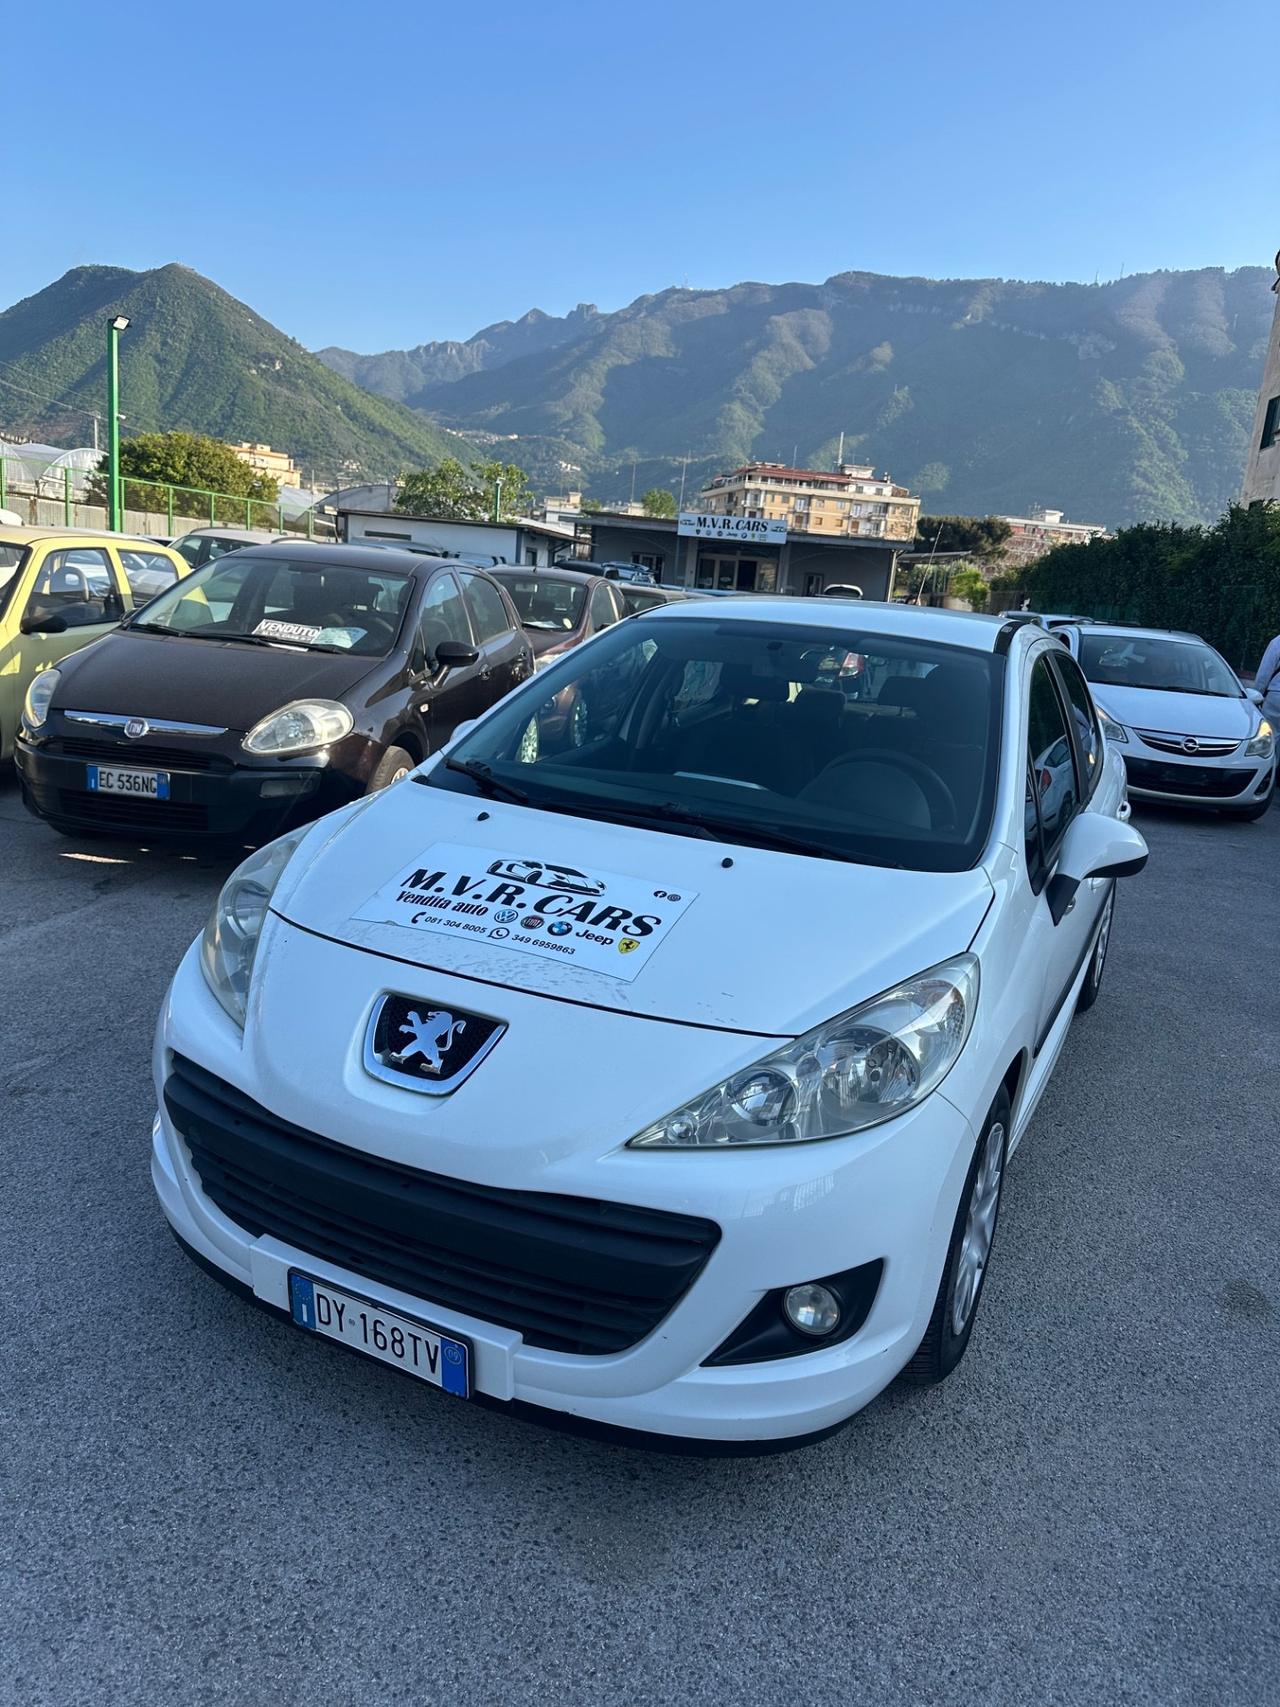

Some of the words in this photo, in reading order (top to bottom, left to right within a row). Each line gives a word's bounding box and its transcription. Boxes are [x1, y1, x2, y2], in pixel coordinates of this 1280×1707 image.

[260, 621, 319, 637] VENDUTO
[98, 771, 114, 789] EC
[396, 890, 452, 910] Vendita
[451, 900, 489, 917] auto
[424, 916, 442, 924] 081
[443, 919, 462, 929] 304
[462, 923, 488, 934] 8005
[511, 934, 531, 944] 349
[532, 939, 576, 956] 6959863
[575, 929, 615, 946] Jeep
[316, 1293, 346, 1332] DY
[359, 1313, 440, 1374] 168TV
